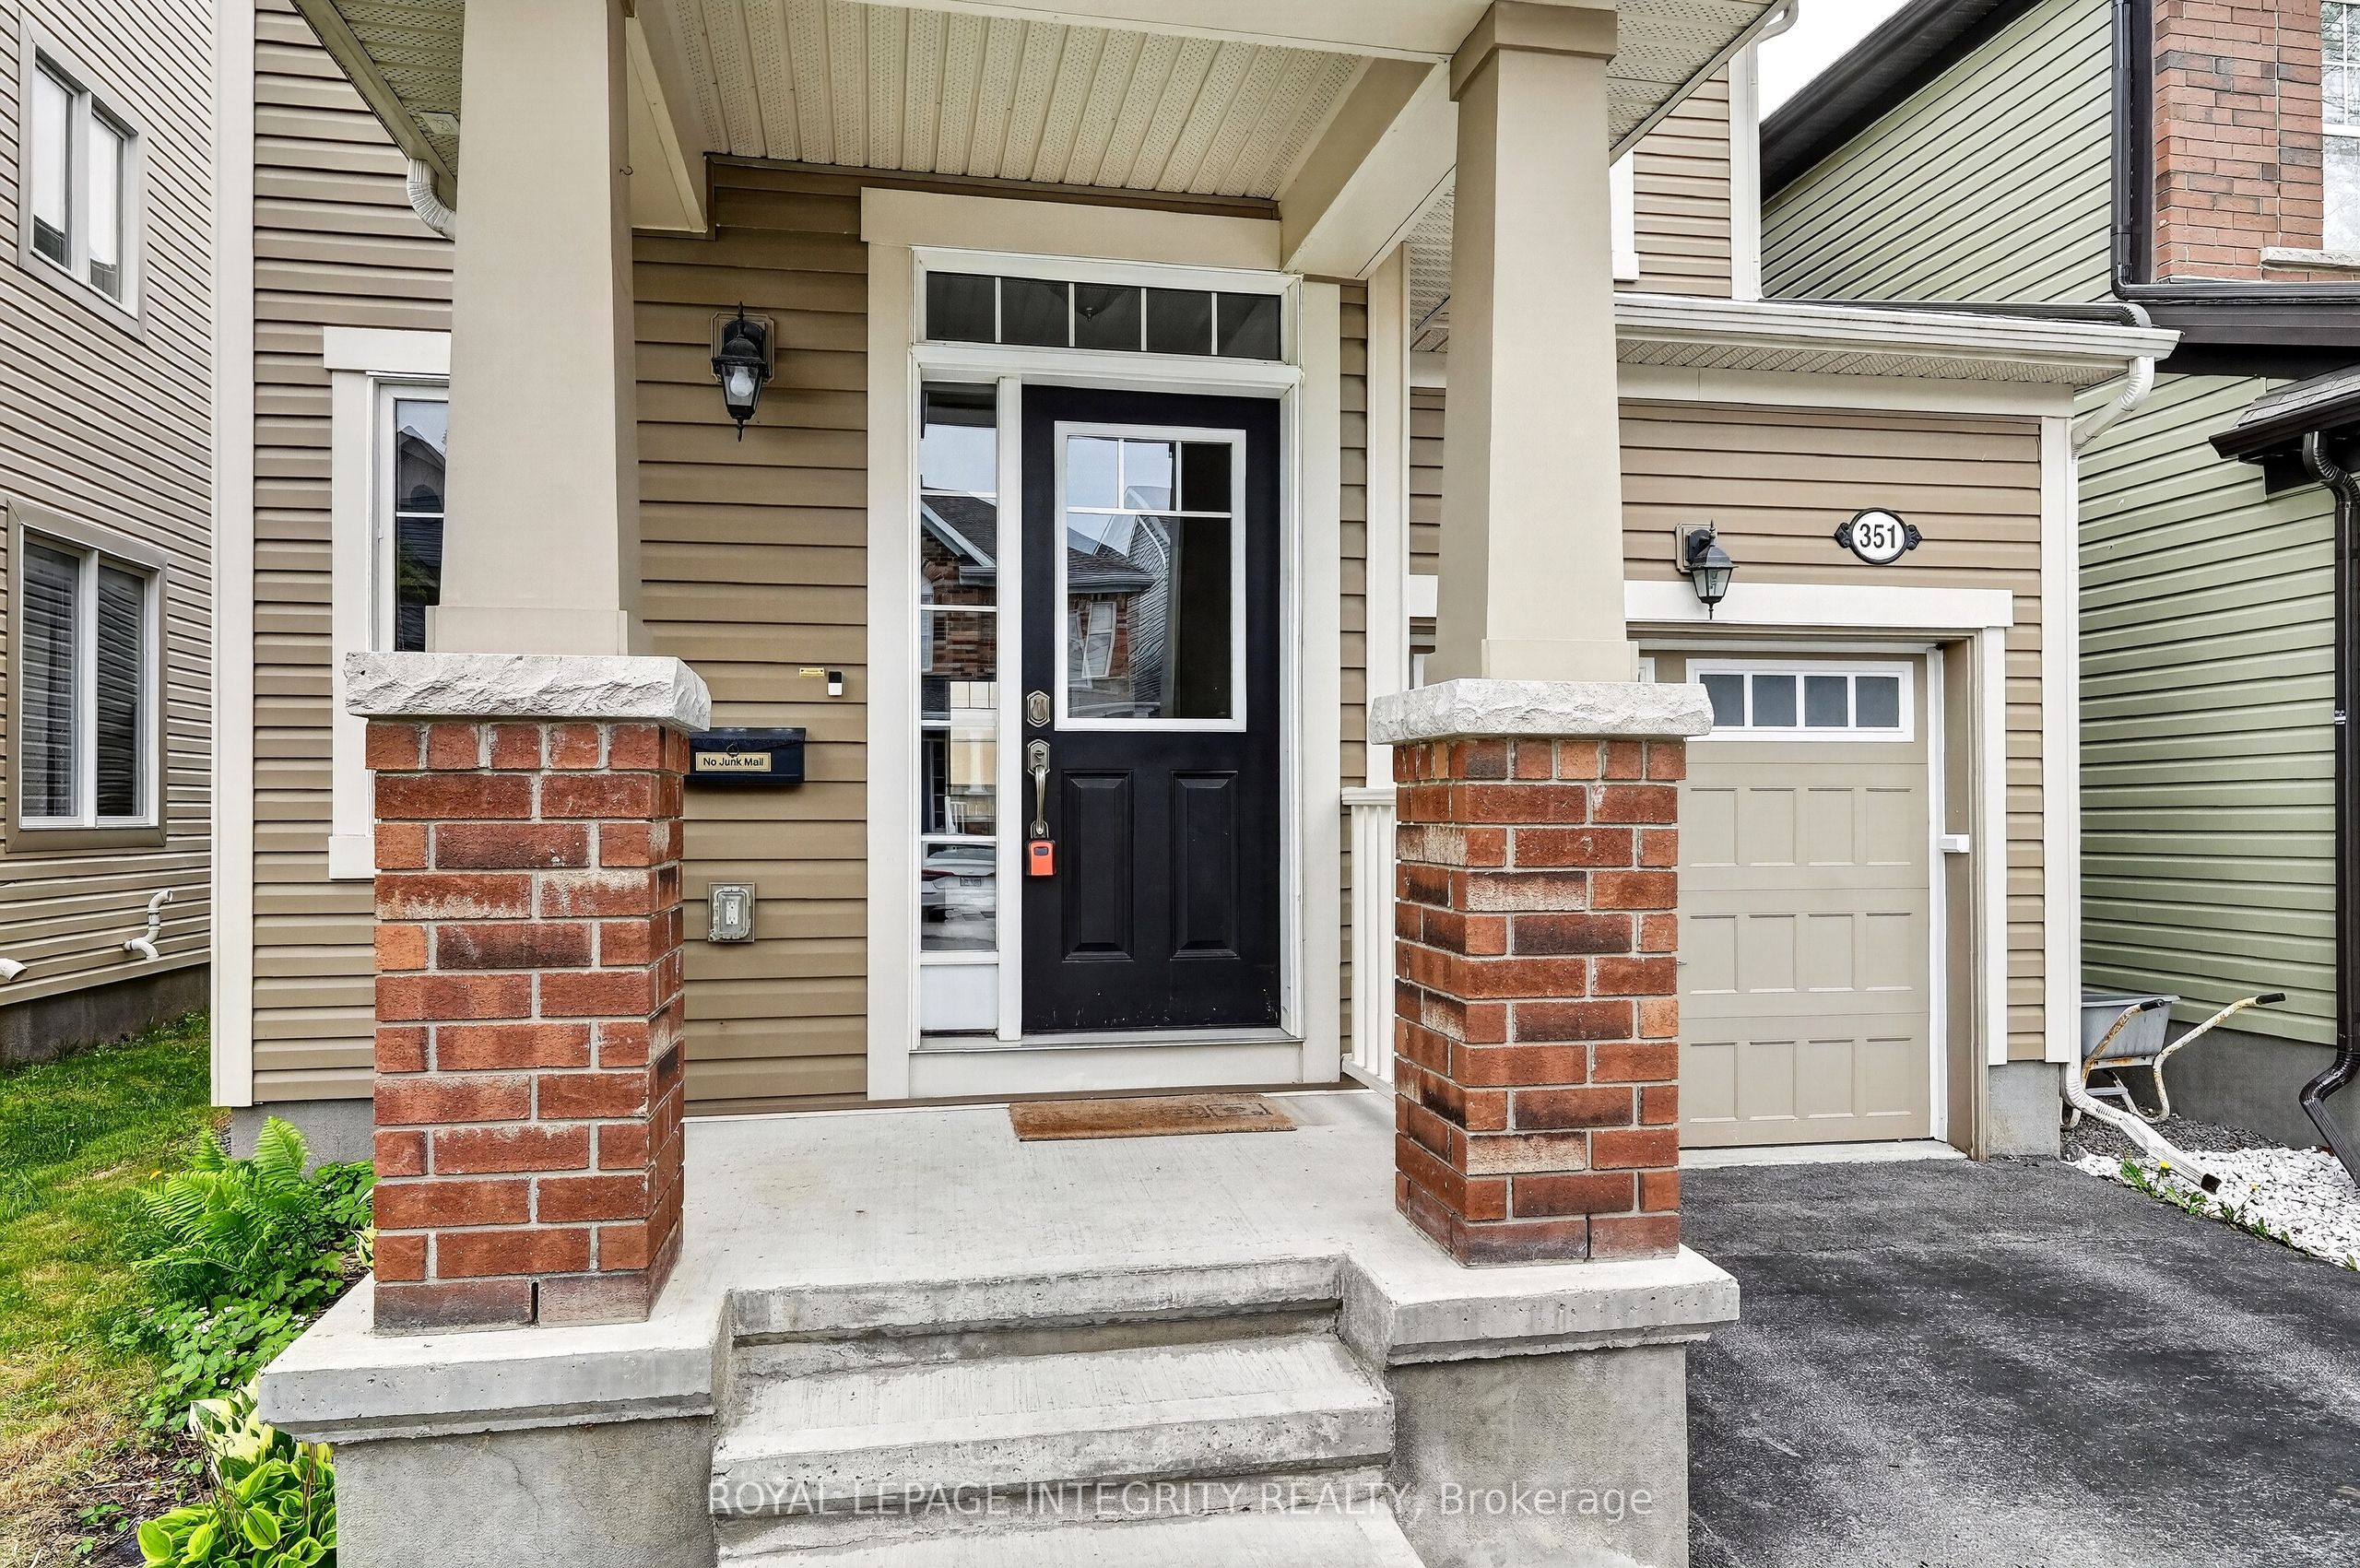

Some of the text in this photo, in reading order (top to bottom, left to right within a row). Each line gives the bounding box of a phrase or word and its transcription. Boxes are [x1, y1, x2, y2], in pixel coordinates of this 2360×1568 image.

[1859, 523, 1895, 548] 351
[702, 757, 764, 767] No Junk Mail
